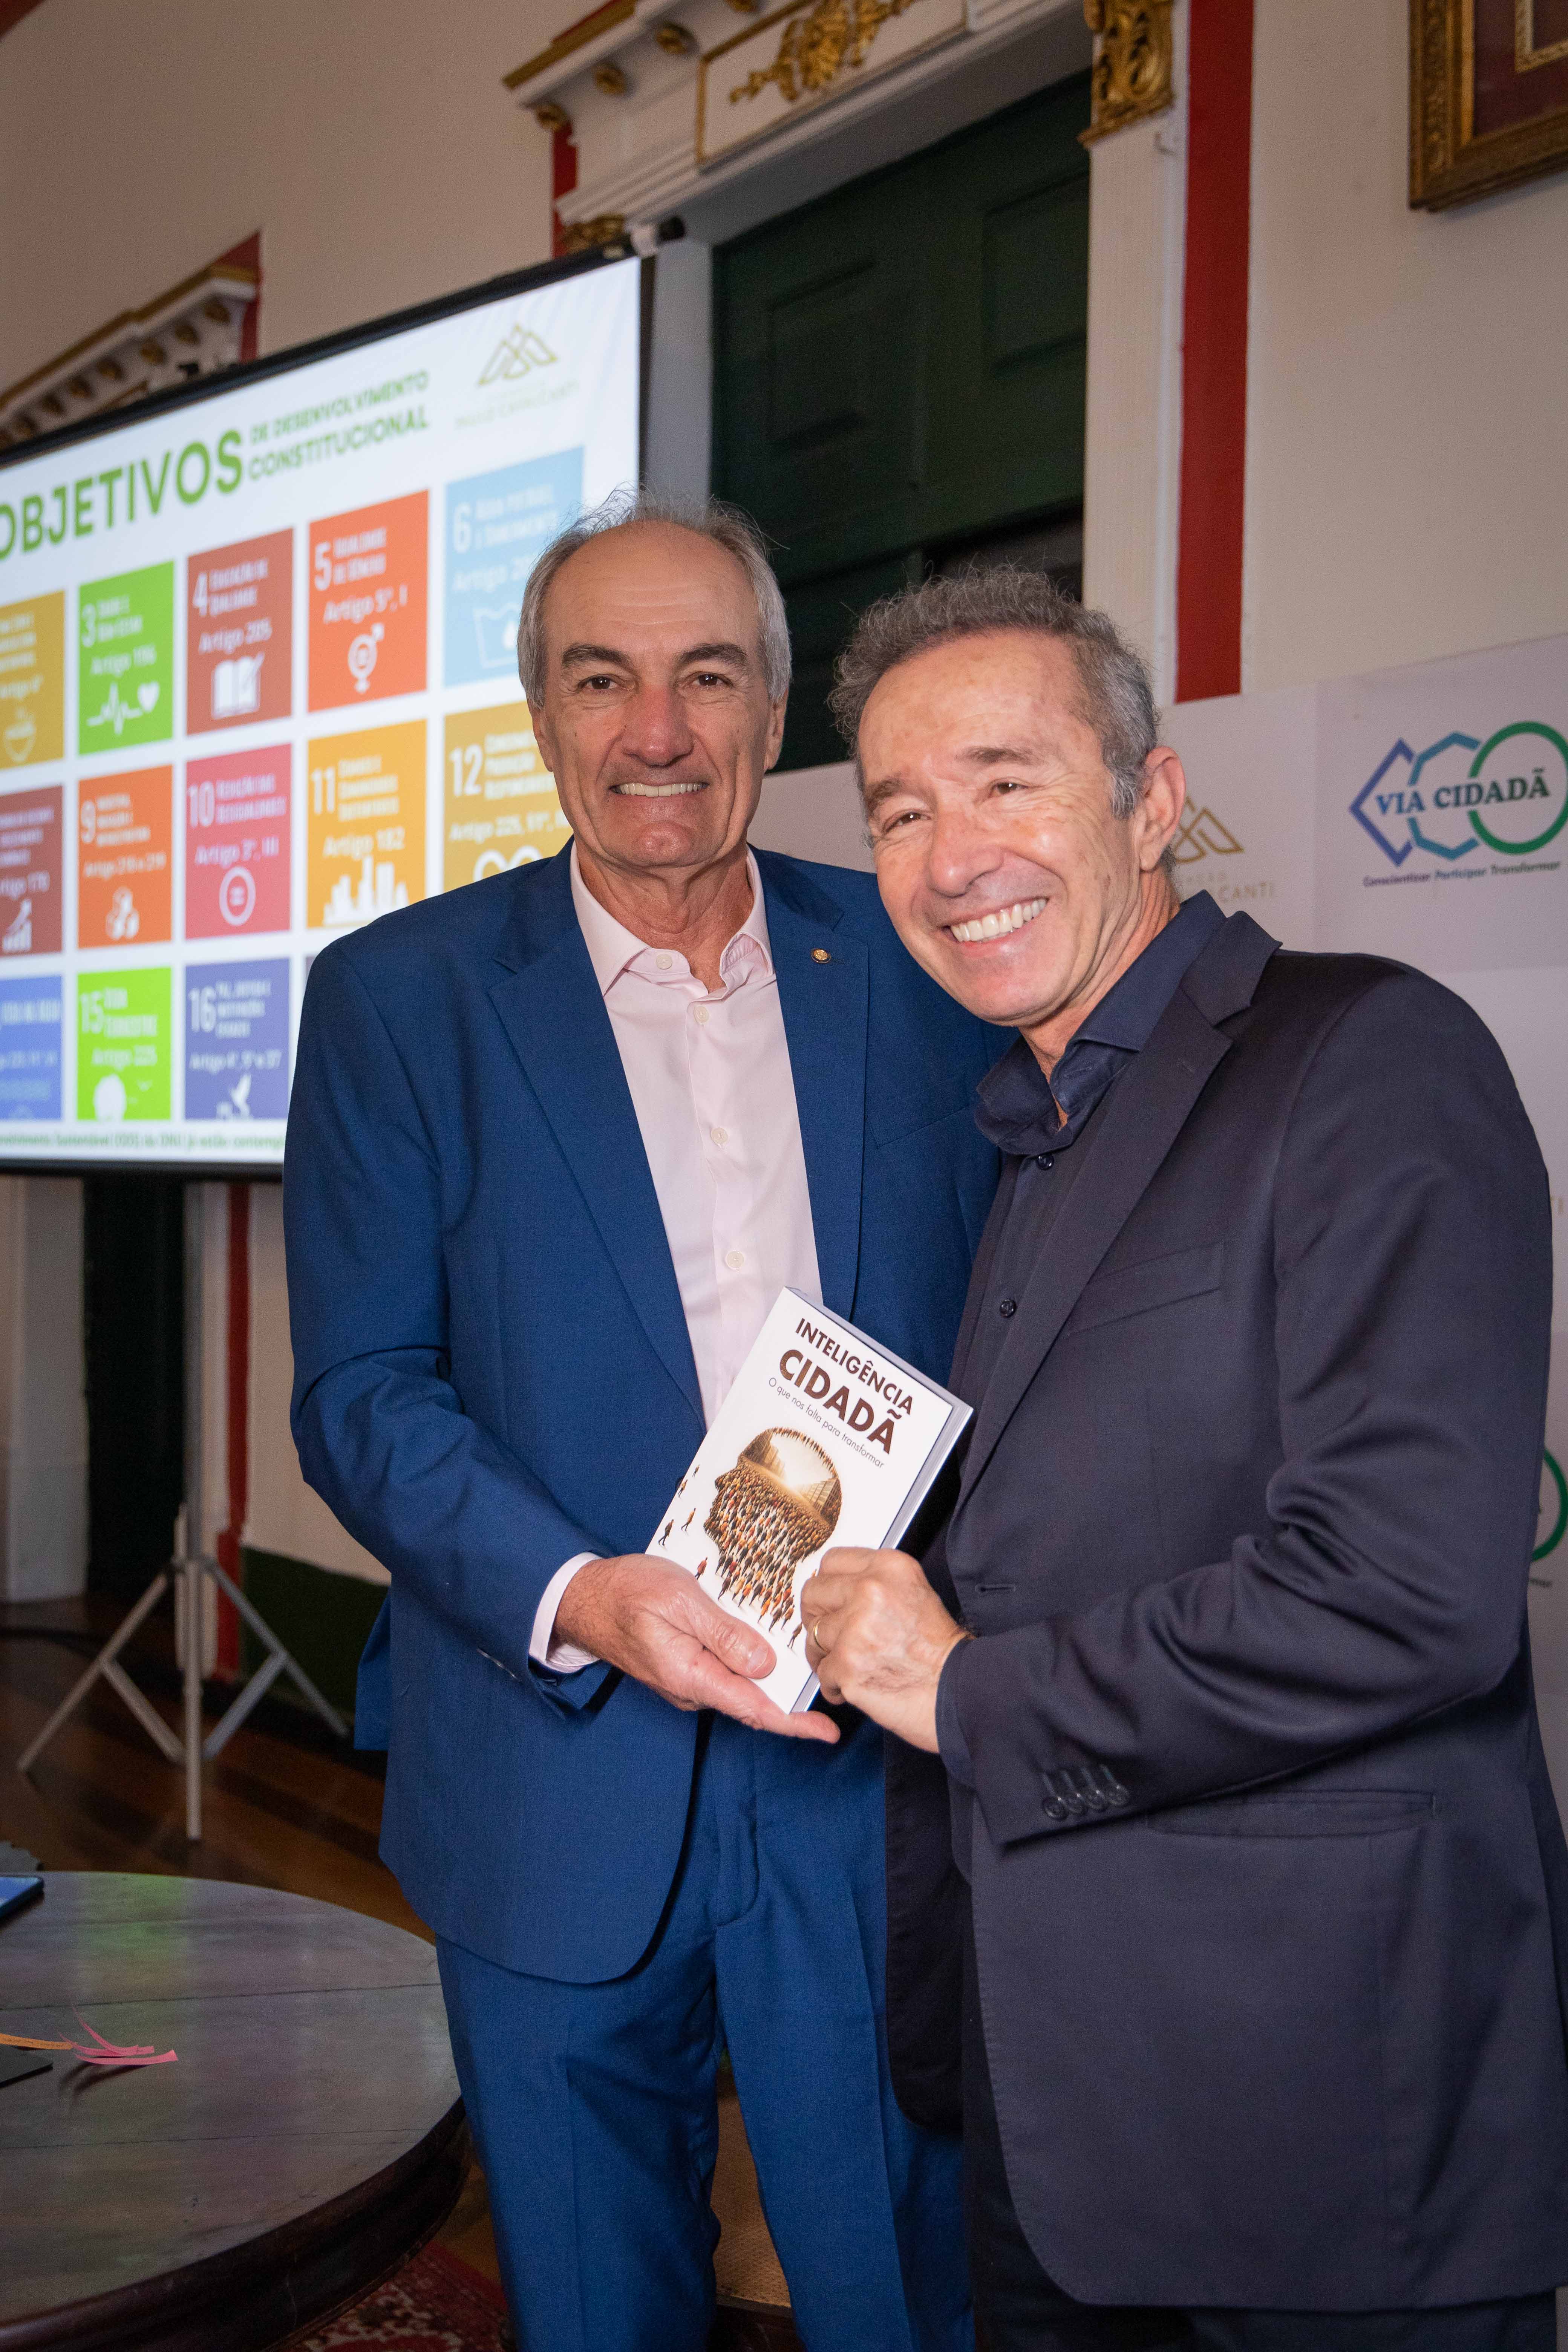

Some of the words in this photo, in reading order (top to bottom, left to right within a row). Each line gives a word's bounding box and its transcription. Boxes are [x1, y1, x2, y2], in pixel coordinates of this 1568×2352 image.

[251, 422, 268, 446] DE
[274, 369, 429, 437] DESENVOLVIMENTO
[248, 404, 428, 481] CONSTITUCIONAL
[453, 501, 472, 554] 6
[314, 540, 332, 591] 5
[193, 572, 207, 617] 4
[324, 594, 374, 625] Artigo
[81, 603, 96, 648] 3
[199, 627, 244, 655] Artigo
[311, 766, 335, 815] 11
[450, 744, 483, 798] 12
[1375, 790, 1426, 816] VIA
[1433, 767, 1550, 810] CIDADÃ
[81, 799, 97, 844] 9
[188, 779, 215, 829] 10
[195, 842, 240, 869] Artigo
[323, 834, 373, 861] Artigo
[1435, 868, 1486, 880] Participar
[1490, 861, 1560, 876] Transformar
[80, 989, 104, 1034] 15
[189, 985, 217, 1034] 16
[795, 1318, 913, 1415] INTELIGÊNCIA
[769, 1377, 777, 1387] O
[777, 1385, 791, 1400] que
[792, 1396, 804, 1410] nos
[805, 1404, 822, 1423] falta
[821, 1421, 841, 1438] para
[842, 1433, 885, 1469] transformar
[779, 1349, 902, 1455] CIDADÃ
